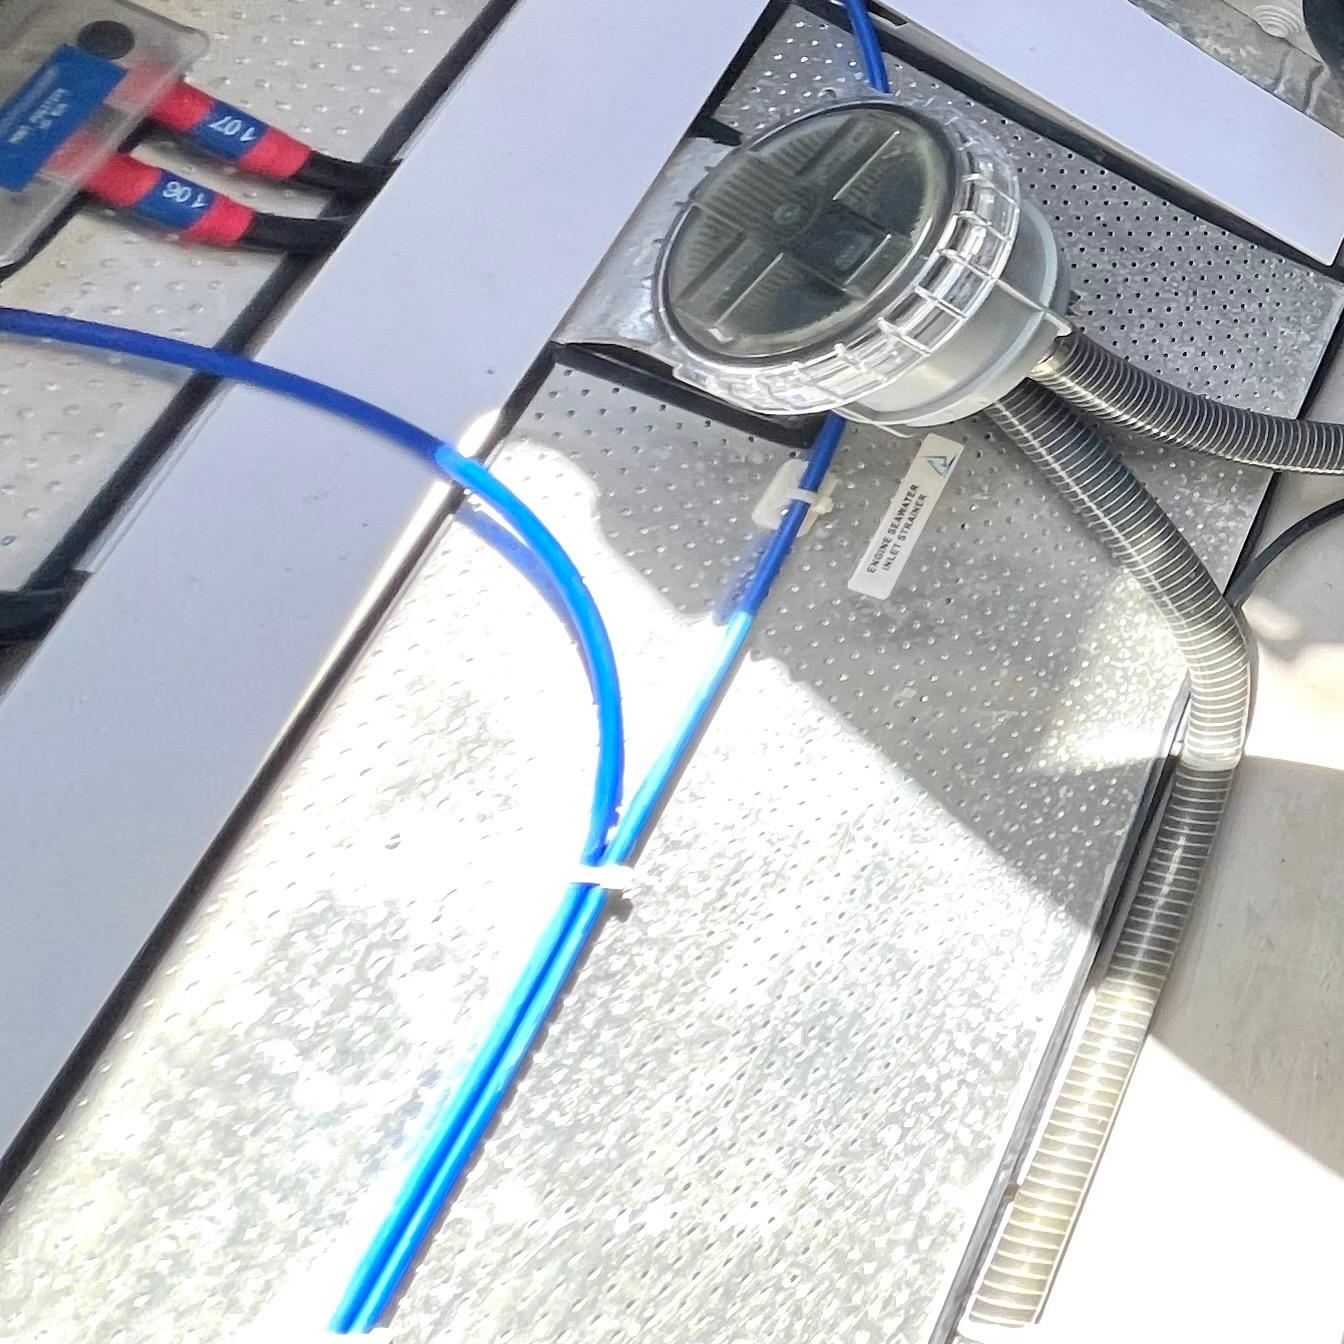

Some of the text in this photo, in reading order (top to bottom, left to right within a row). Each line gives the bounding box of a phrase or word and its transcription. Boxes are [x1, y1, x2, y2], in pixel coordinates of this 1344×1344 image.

[867, 484, 919, 574] ENGINE SEAWATER
[882, 494, 927, 571] INLET STRAINER
